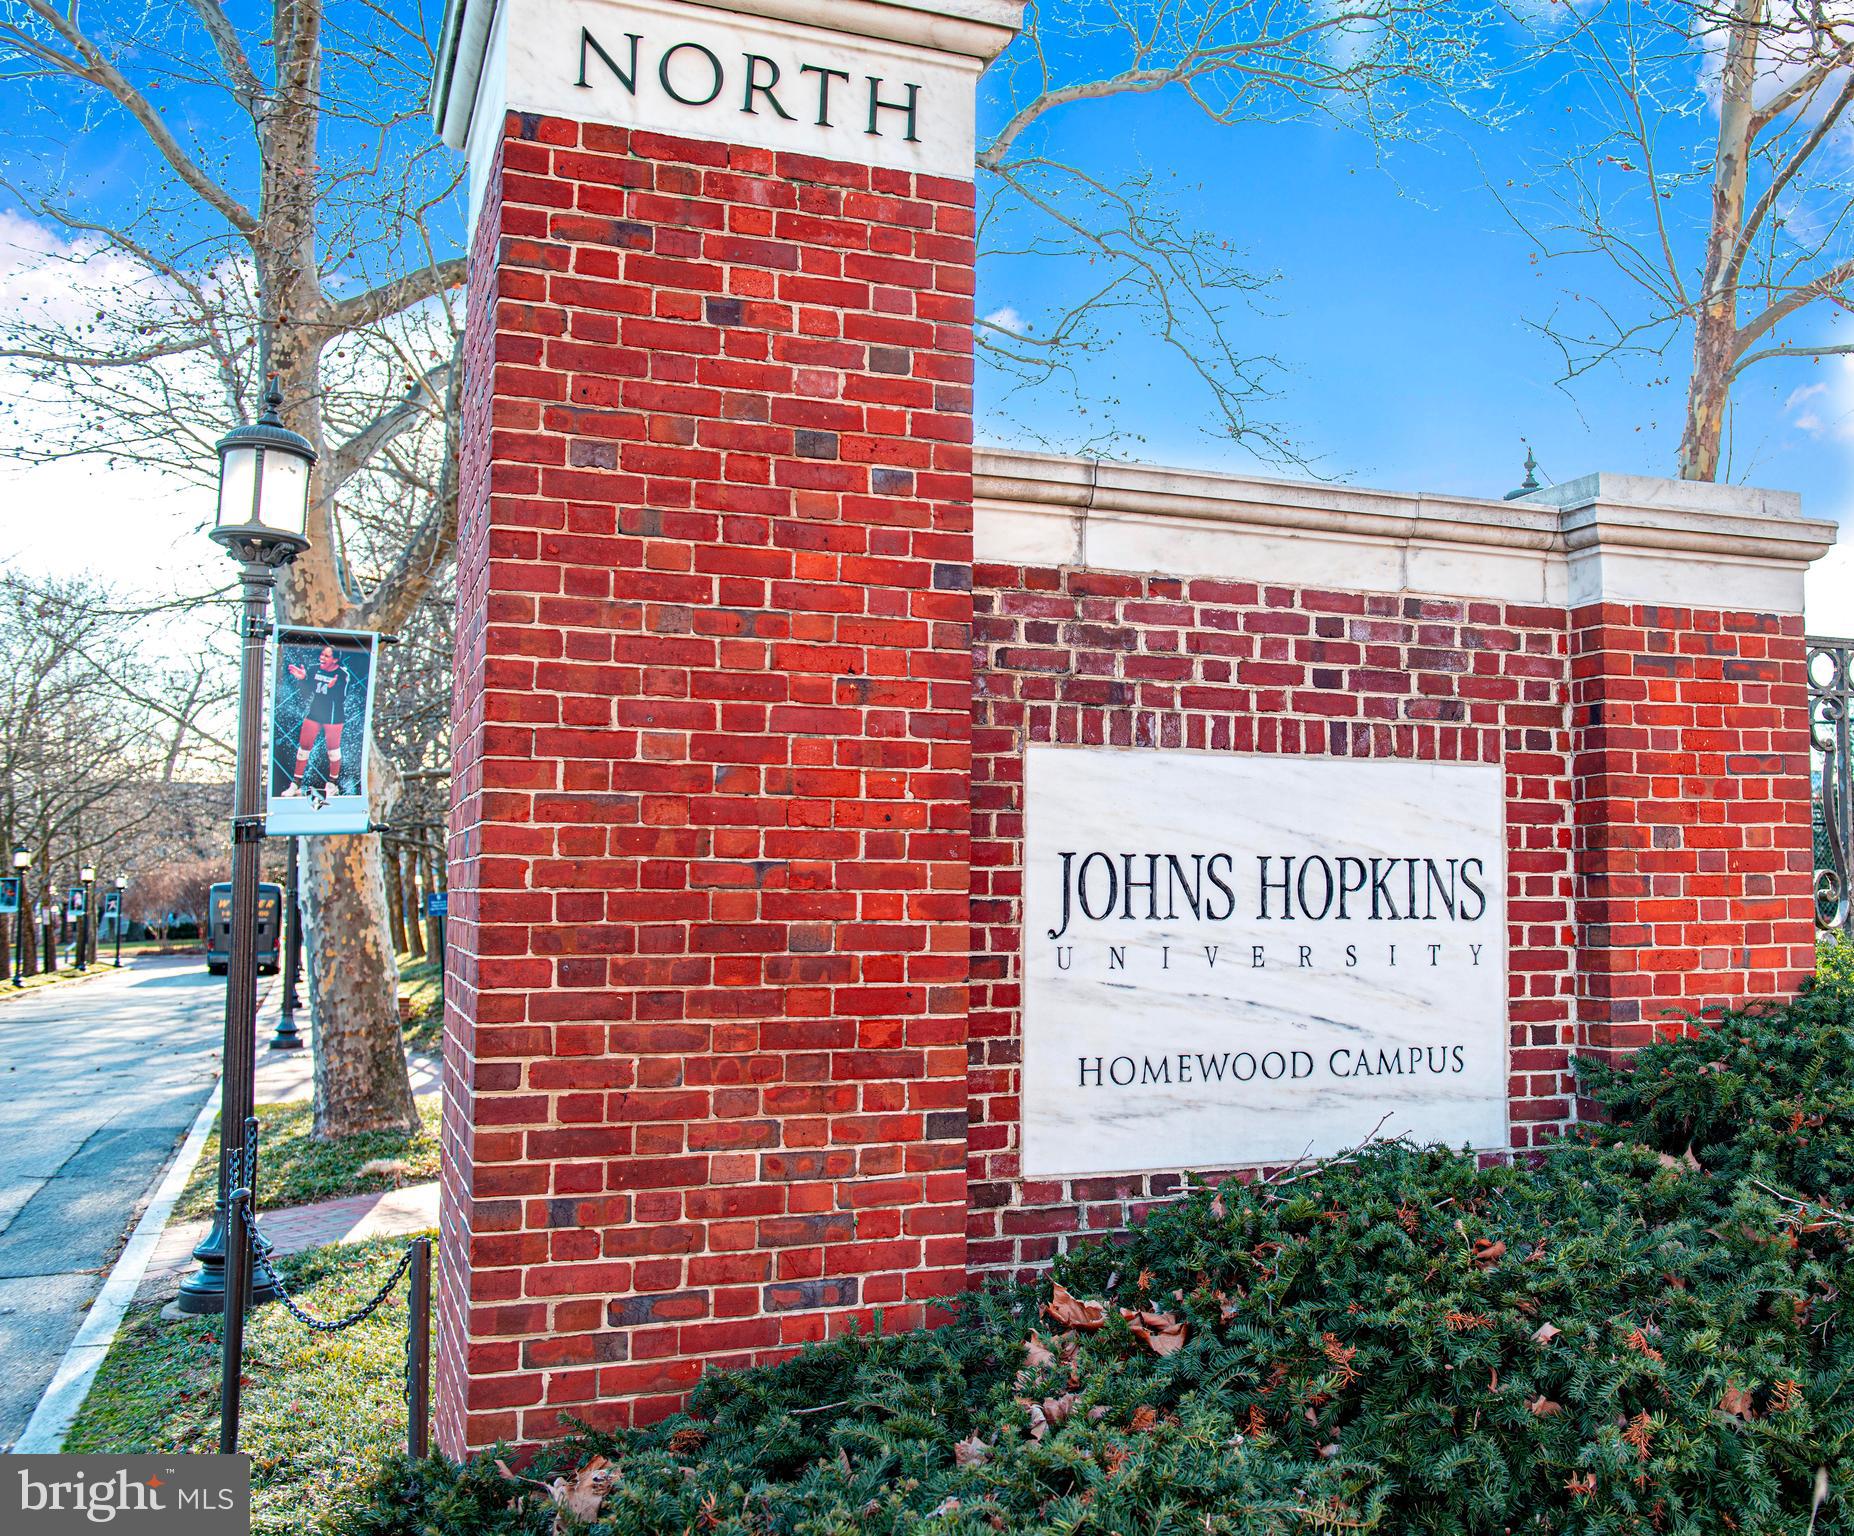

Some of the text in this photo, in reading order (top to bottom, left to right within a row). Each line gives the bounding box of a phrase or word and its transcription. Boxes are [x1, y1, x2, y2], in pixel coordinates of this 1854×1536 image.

[573, 26, 922, 143] NORTH
[1047, 851, 1486, 940] JOHNS HOPKINS
[1056, 944, 1483, 970] UNIVERSITY
[1078, 1045, 1465, 1087] HOMEWOOD CAMPUS
